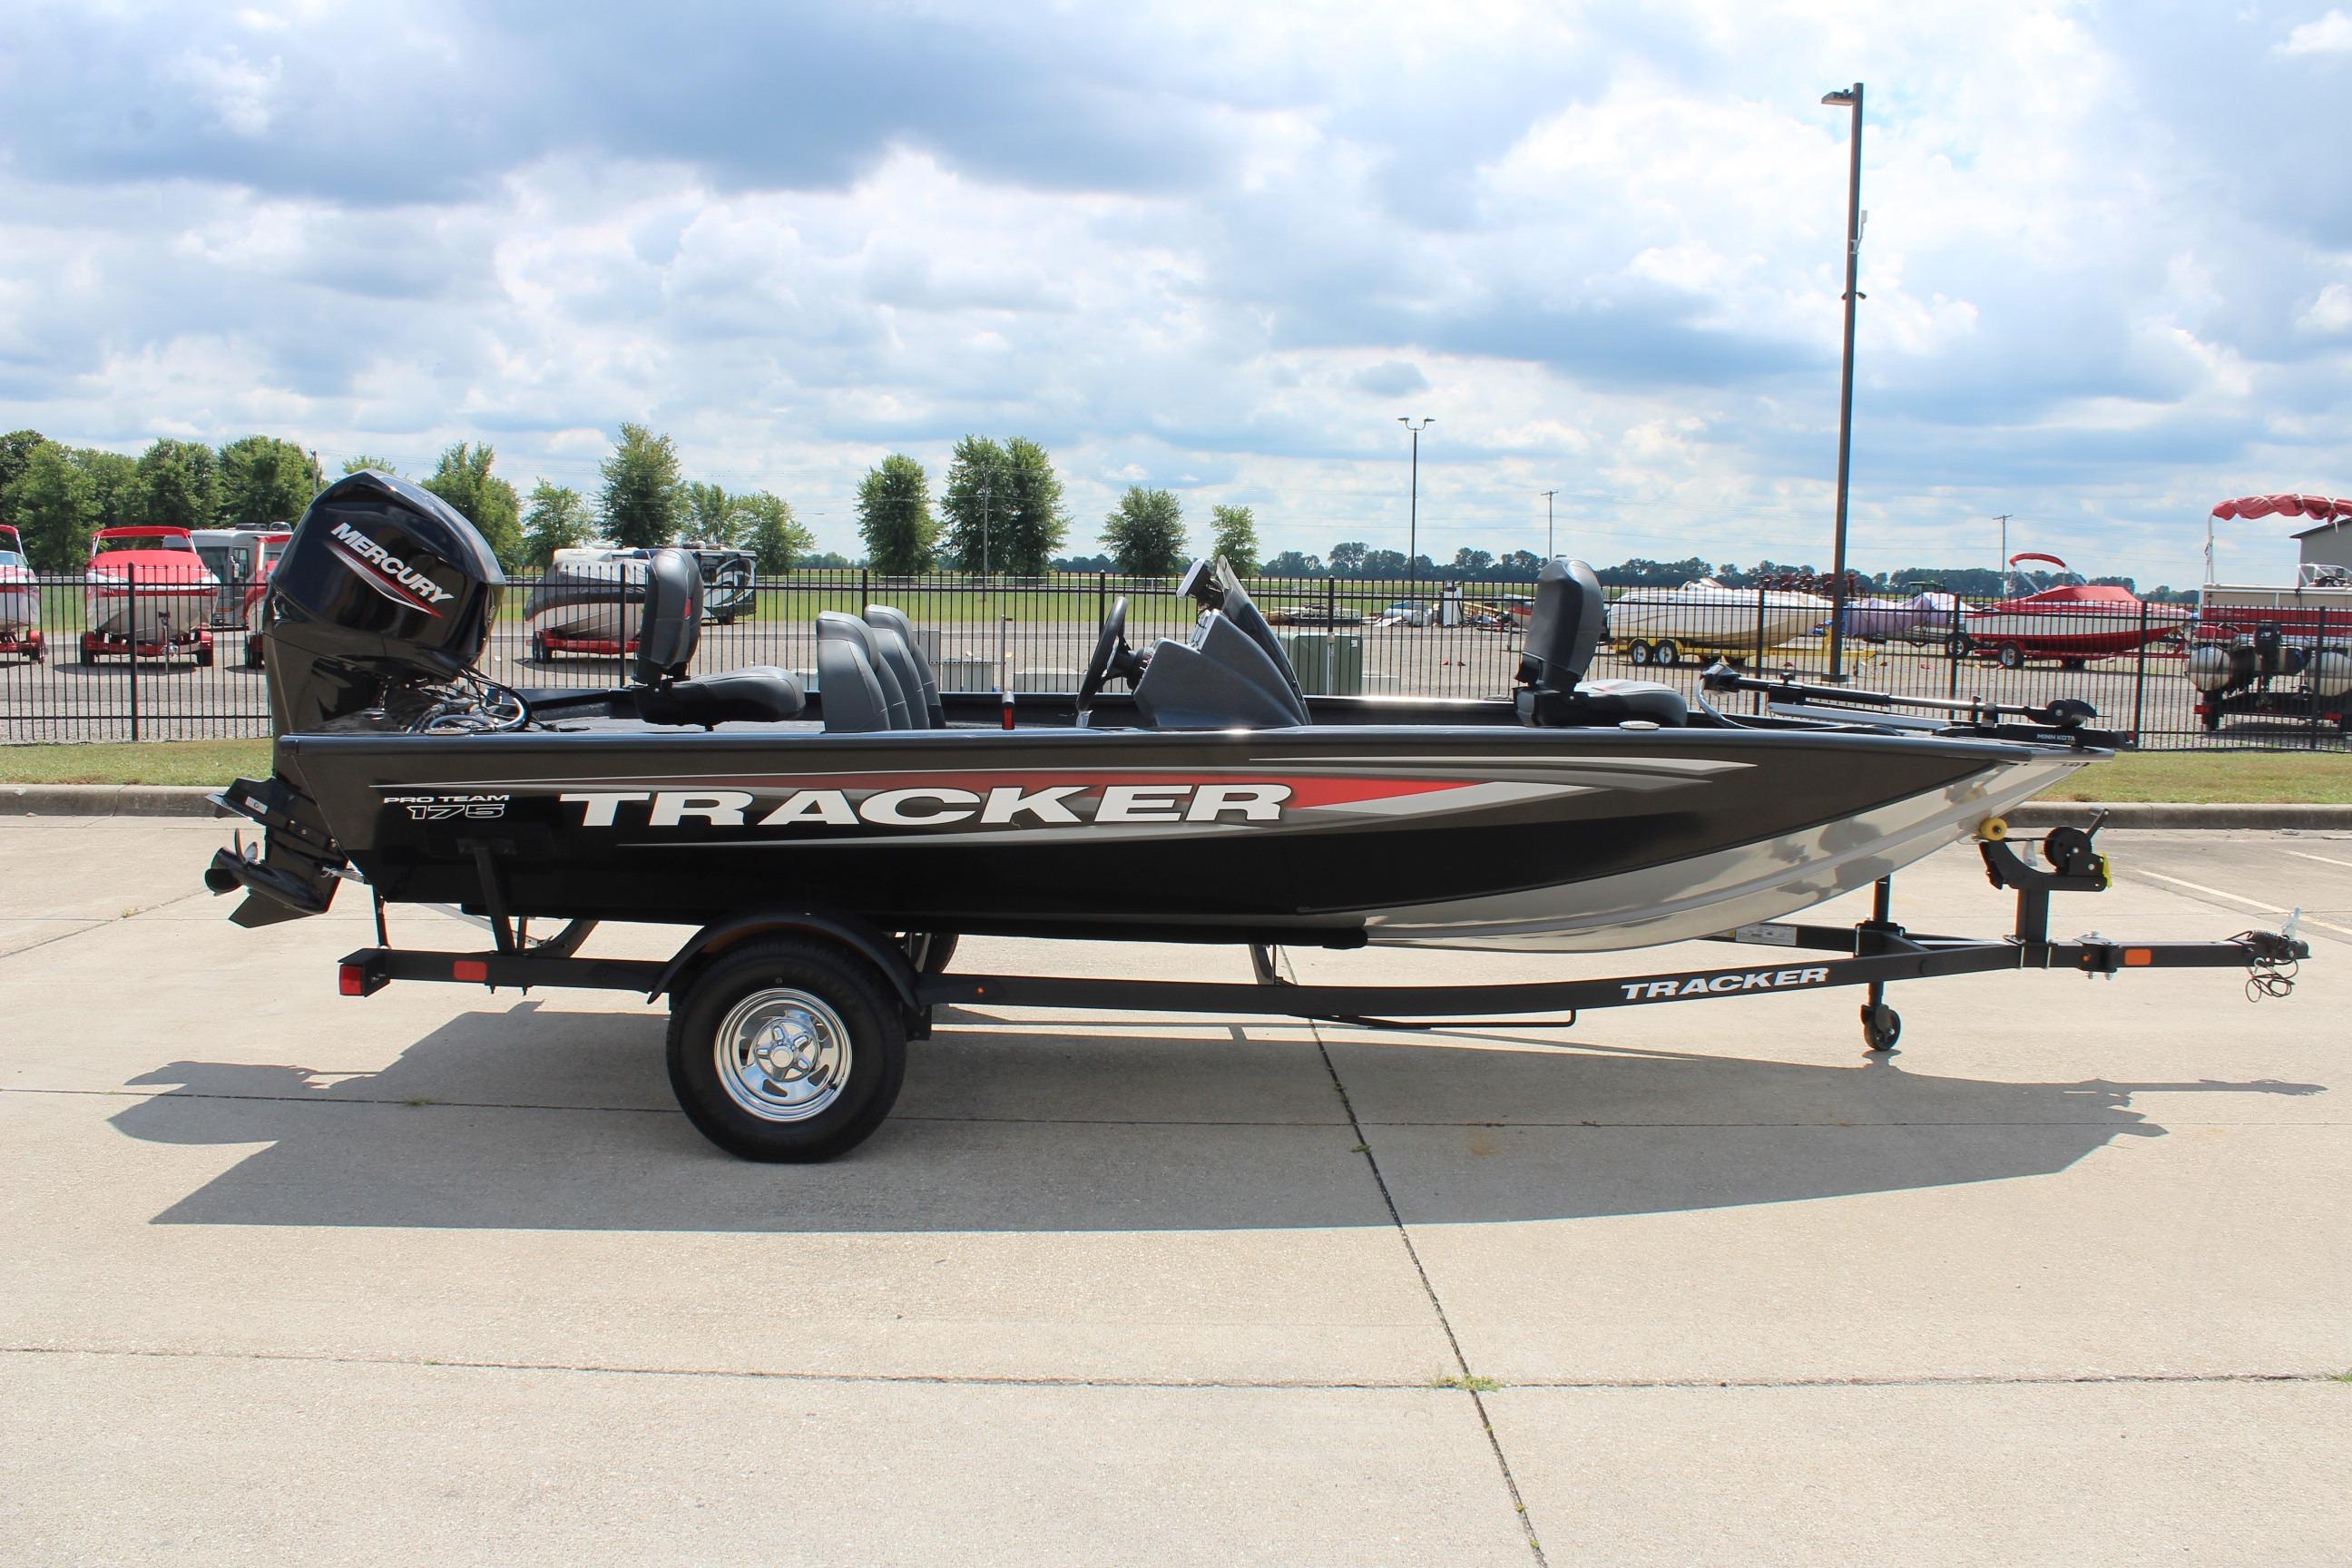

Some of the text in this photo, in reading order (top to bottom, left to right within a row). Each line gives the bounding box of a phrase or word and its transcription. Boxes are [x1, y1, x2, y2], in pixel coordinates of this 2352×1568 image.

[330, 522, 454, 603] MERCURY
[406, 803, 505, 820] 175
[438, 794, 511, 803] TEAM
[558, 784, 1292, 827] TRACKER
[1621, 967, 1829, 1000] TRACKER
